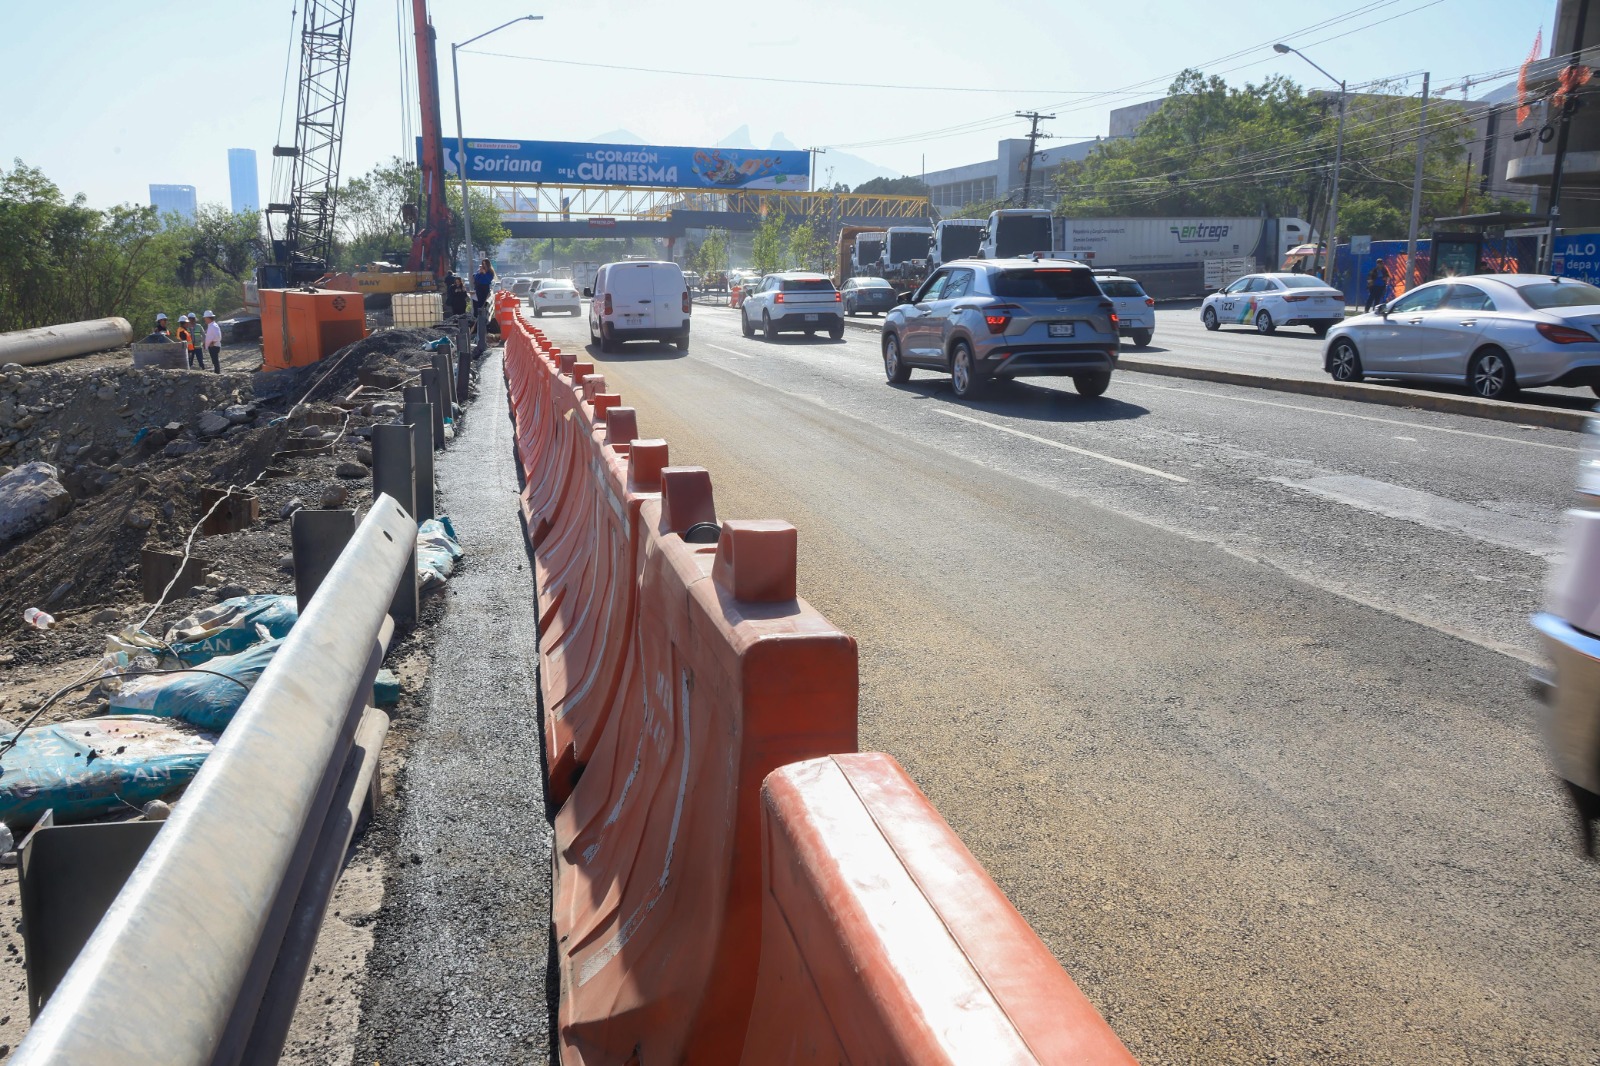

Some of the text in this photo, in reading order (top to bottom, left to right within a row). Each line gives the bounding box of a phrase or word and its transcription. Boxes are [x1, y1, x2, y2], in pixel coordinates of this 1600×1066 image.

[586, 147, 658, 163] EL CORAZÓN
[473, 155, 542, 172] Soriana
[567, 168, 576, 179] LA
[577, 162, 678, 182] CUARESMA
[1565, 243, 1596, 256] ALO
[1567, 260, 1592, 271] depa
[358, 279, 381, 287] SANY
